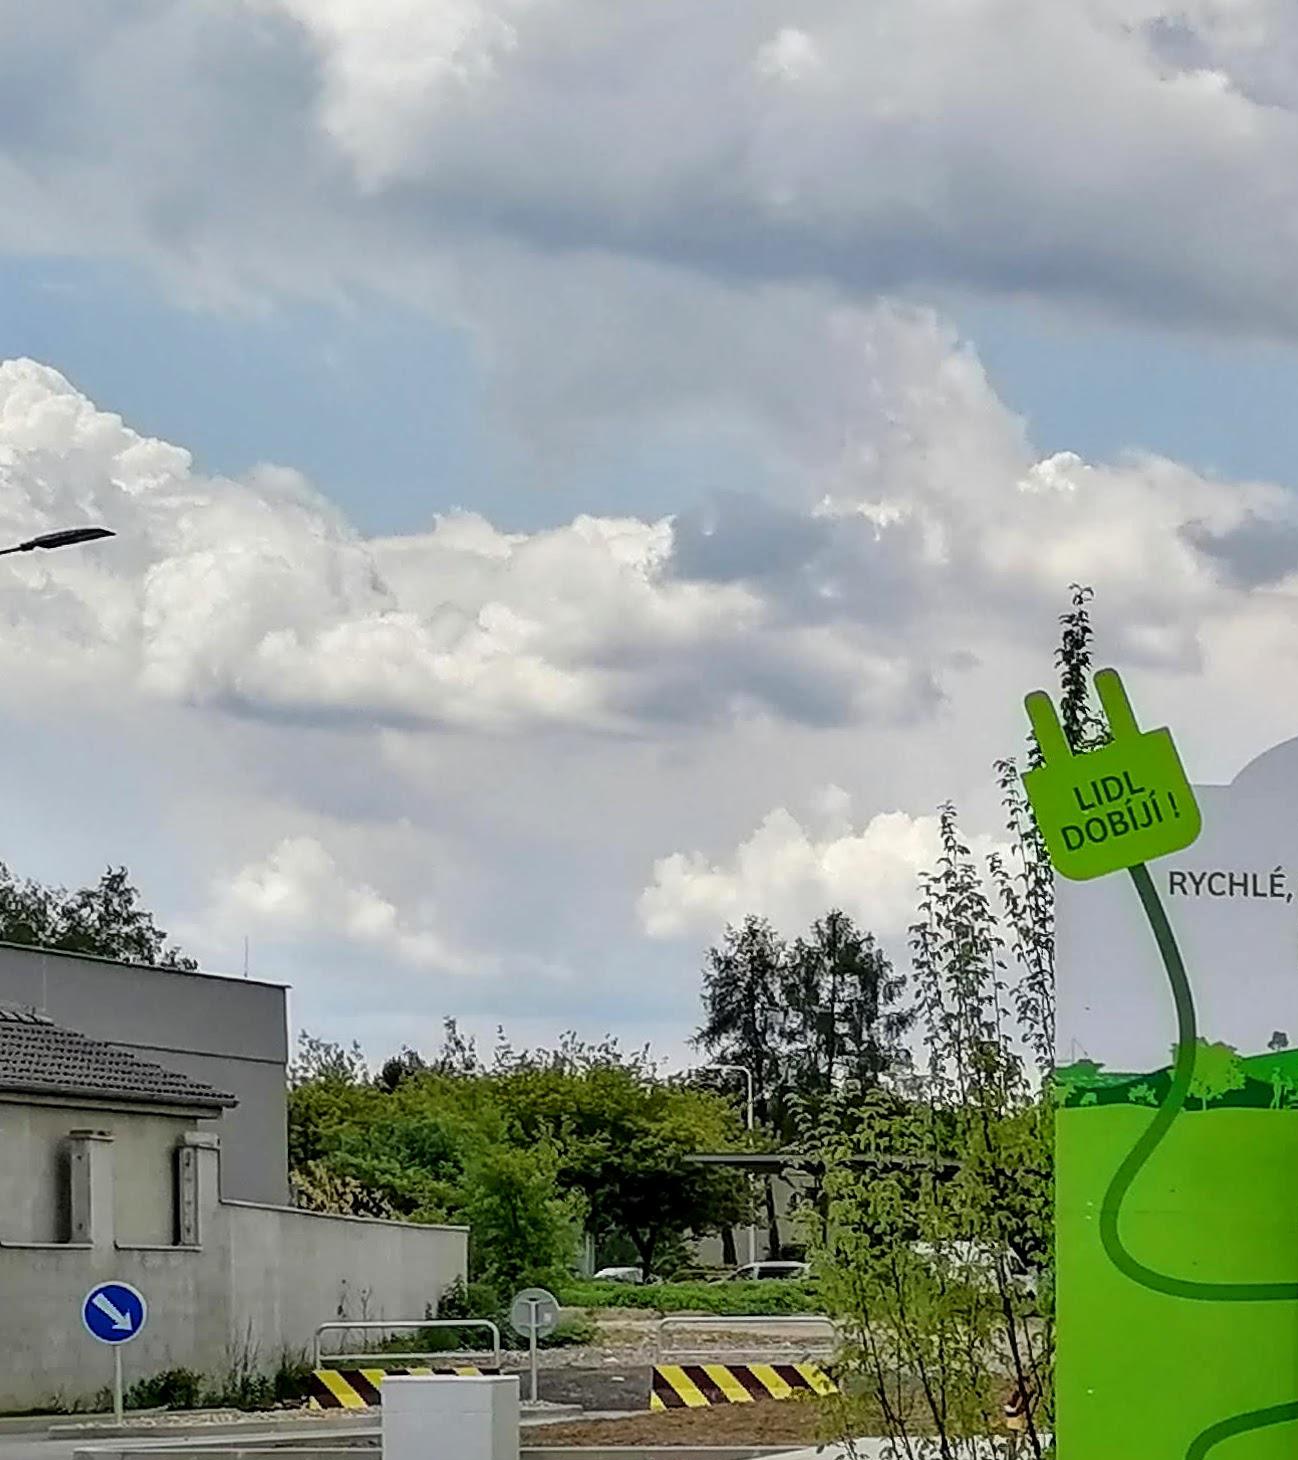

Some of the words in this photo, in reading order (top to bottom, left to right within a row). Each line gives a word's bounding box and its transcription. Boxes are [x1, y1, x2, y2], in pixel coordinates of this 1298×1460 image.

[1073, 771, 1145, 811] LIDL
[1061, 789, 1163, 851] DOBÍJÍ
[1169, 865, 1293, 903] RYCHLÉ,
